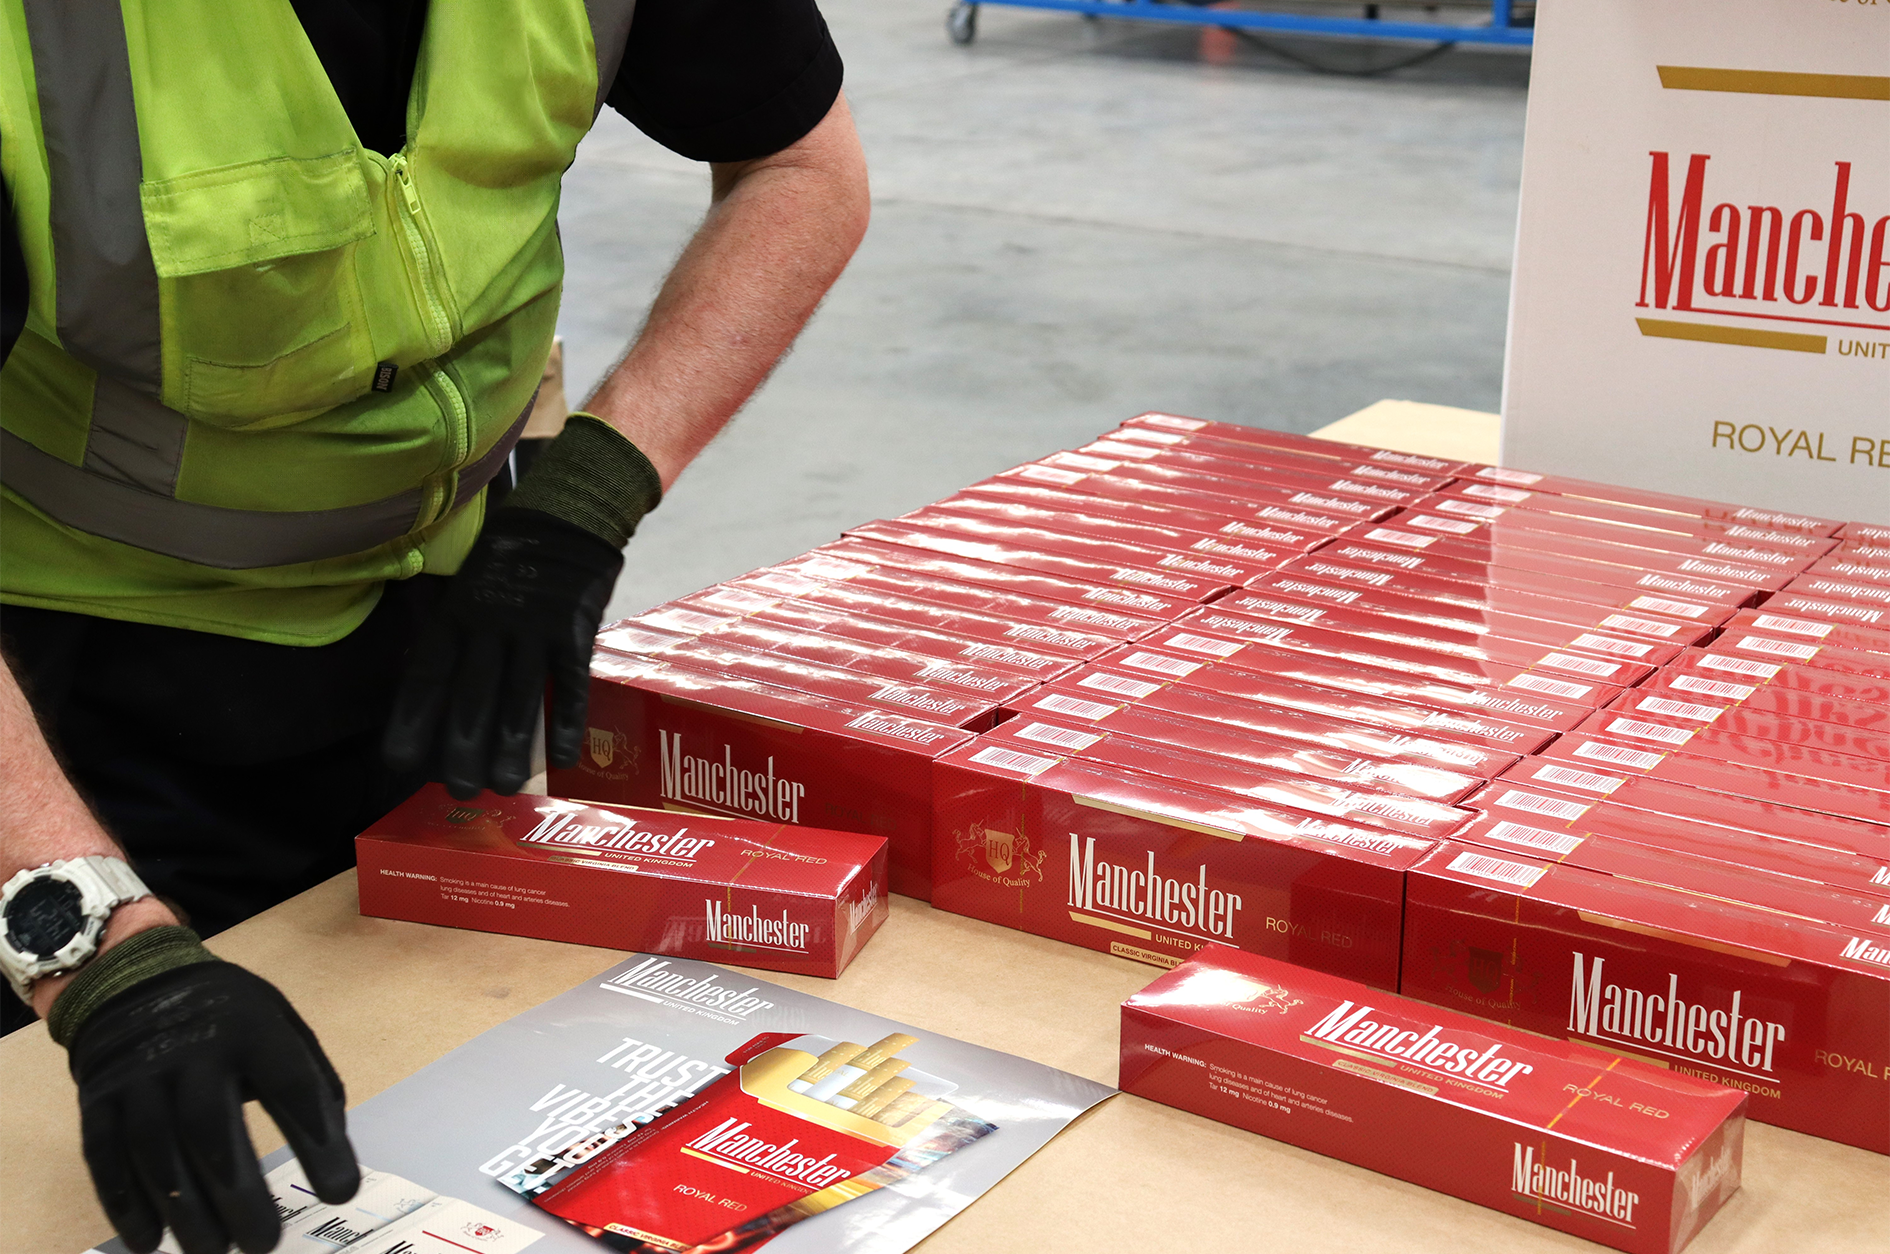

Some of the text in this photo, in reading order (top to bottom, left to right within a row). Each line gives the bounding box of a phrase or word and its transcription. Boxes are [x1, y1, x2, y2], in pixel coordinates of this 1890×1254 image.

[1711, 419, 1837, 462] ROYAL
[1370, 450, 1449, 469] Manchester
[1350, 465, 1430, 484] Manchester
[1288, 492, 1371, 513] Manchester
[1328, 480, 1410, 500] Manchester
[1256, 506, 1339, 528] Manchester
[1732, 508, 1823, 528] Manchester
[1219, 521, 1304, 544] Manchester
[1724, 525, 1816, 548] Manchester
[1190, 537, 1276, 561] Manchester
[1701, 542, 1794, 565] Manchester
[1156, 553, 1244, 577] Manchester
[1677, 559, 1770, 582] Manchester
[1109, 568, 1197, 592] Manchester
[1636, 573, 1731, 598] Manchester
[1081, 588, 1171, 612] Manchester
[1785, 598, 1884, 623] Manchester
[1200, 614, 1294, 642] Manchester
[867, 684, 965, 716] Manchester
[1461, 690, 1563, 721] Manchester
[844, 710, 944, 745] Manchester
[592, 737, 611, 761] HQ
[659, 729, 805, 823] Manchester
[520, 811, 715, 860] Manchester
[604, 852, 694, 868] UNITED KINGDOM
[740, 849, 828, 865] ROYAL RED
[989, 840, 1010, 866] HQ
[380, 869, 405, 878] HEALTH
[405, 872, 438, 882] WARNING:
[440, 876, 464, 886] Smoking
[475, 881, 489, 889] main
[490, 883, 506, 891] cause
[507, 883, 514, 892] of
[514, 885, 526, 895] lung
[527, 888, 546, 896] cancer
[967, 863, 1031, 888] House of Quality
[1067, 832, 1243, 944] Manchester
[440, 885, 452, 894] lung
[453, 886, 477, 896] diseases
[478, 888, 489, 897] and
[511, 893, 523, 901] and
[459, 896, 469, 904] mg
[471, 896, 494, 906] Nicotine
[705, 899, 809, 951] Manchester
[1266, 916, 1353, 948] ROYAL RED
[1112, 944, 1140, 957] CLASSIC
[1141, 952, 1170, 965] VIRGINIA
[1155, 933, 1192, 950] UNITED
[607, 956, 775, 1018] Manchester
[663, 1000, 740, 1026] UNITED KINGDOM
[1232, 1003, 1268, 1015] Quality
[1567, 951, 1786, 1078] Manchester
[1304, 1000, 1534, 1090] Manchester
[596, 1037, 731, 1092] TRUST
[1144, 1043, 1171, 1057] HEALTH
[1172, 1051, 1207, 1068] WARNING:
[1209, 1063, 1236, 1077] Smoking
[1249, 1075, 1264, 1086] main
[1264, 1081, 1283, 1092] cause
[1284, 1085, 1292, 1093] of
[1292, 1087, 1306, 1100] lung
[1306, 1094, 1328, 1105] cancer
[1815, 1050, 1878, 1079] ROYAL
[1209, 1072, 1222, 1083] lung
[1223, 1076, 1250, 1091] diseases
[1250, 1085, 1263, 1095] and
[1263, 1088, 1270, 1097] of
[1270, 1090, 1287, 1103] heart
[1288, 1095, 1300, 1106] and
[1301, 1100, 1324, 1115] arteries
[1400, 1065, 1504, 1100] UNITED KINGDOM
[1674, 1064, 1781, 1099] UNITED KINGDOM
[529, 1083, 655, 1138] VIBES
[1208, 1082, 1291, 1114] Tar 12 mg Nicotine 0.9 mg
[1562, 1083, 1670, 1119] ROYAL RED
[685, 1116, 851, 1189] Manchester
[750, 1171, 780, 1186] UNITED
[1511, 1142, 1639, 1226] Manchester
[673, 1184, 748, 1212] ROYAL RED
